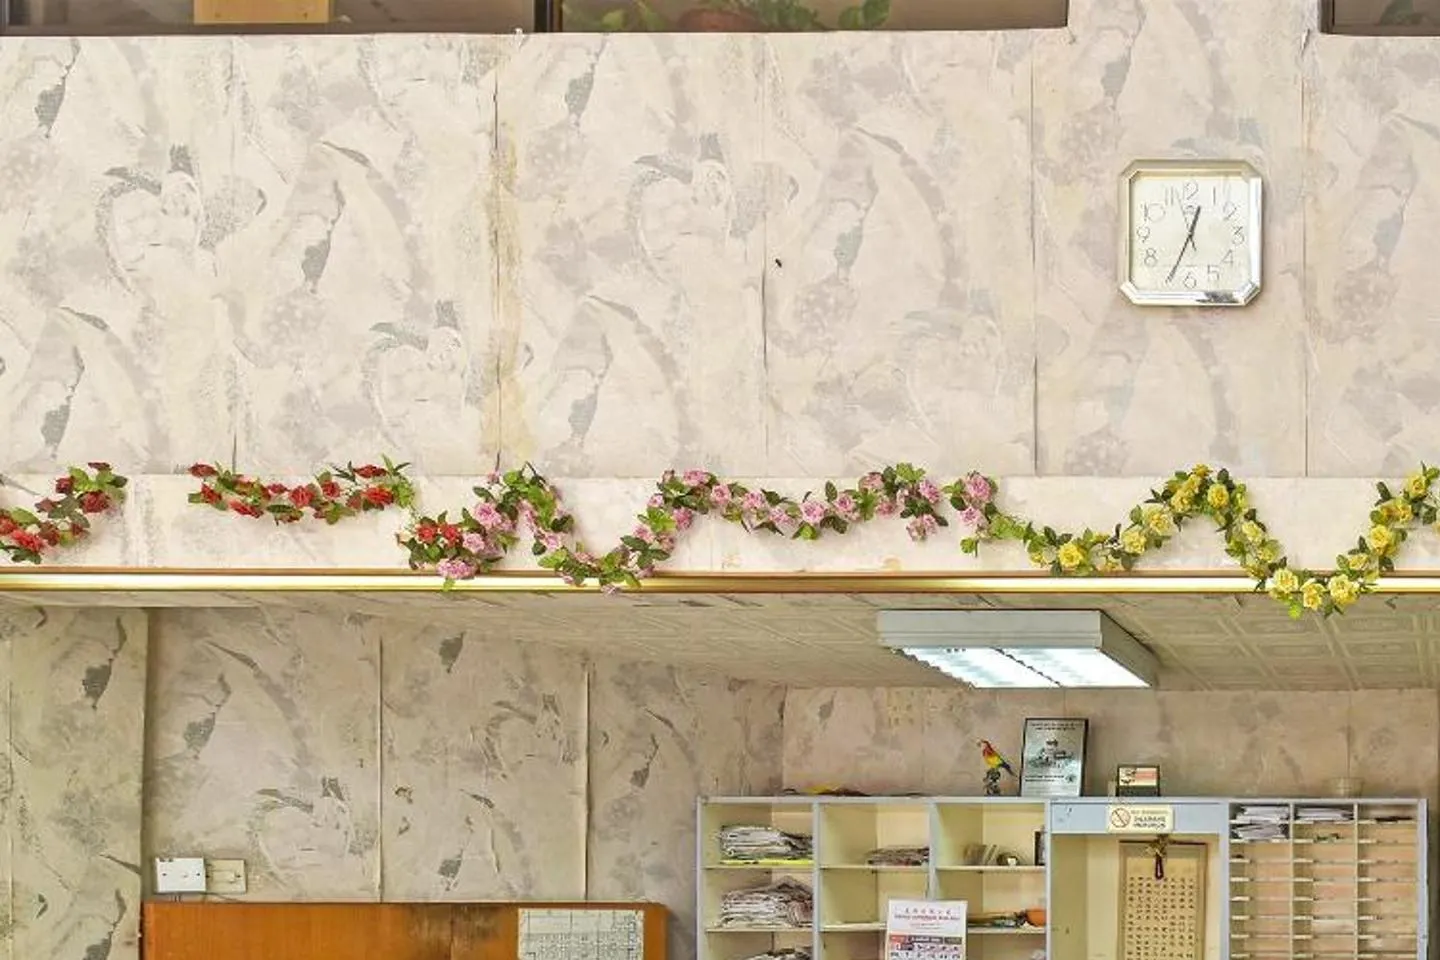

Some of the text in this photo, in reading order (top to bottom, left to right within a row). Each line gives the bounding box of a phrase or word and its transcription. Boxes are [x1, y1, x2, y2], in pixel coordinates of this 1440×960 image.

[1143, 203, 1167, 223] 10
[1222, 201, 1237, 221] 2
[1136, 225, 1151, 244] 9
[1231, 225, 1246, 246] 3
[1143, 247, 1158, 268] 8
[1219, 248, 1235, 267] 4
[1182, 270, 1198, 290] 6
[1207, 264, 1220, 283] 5
